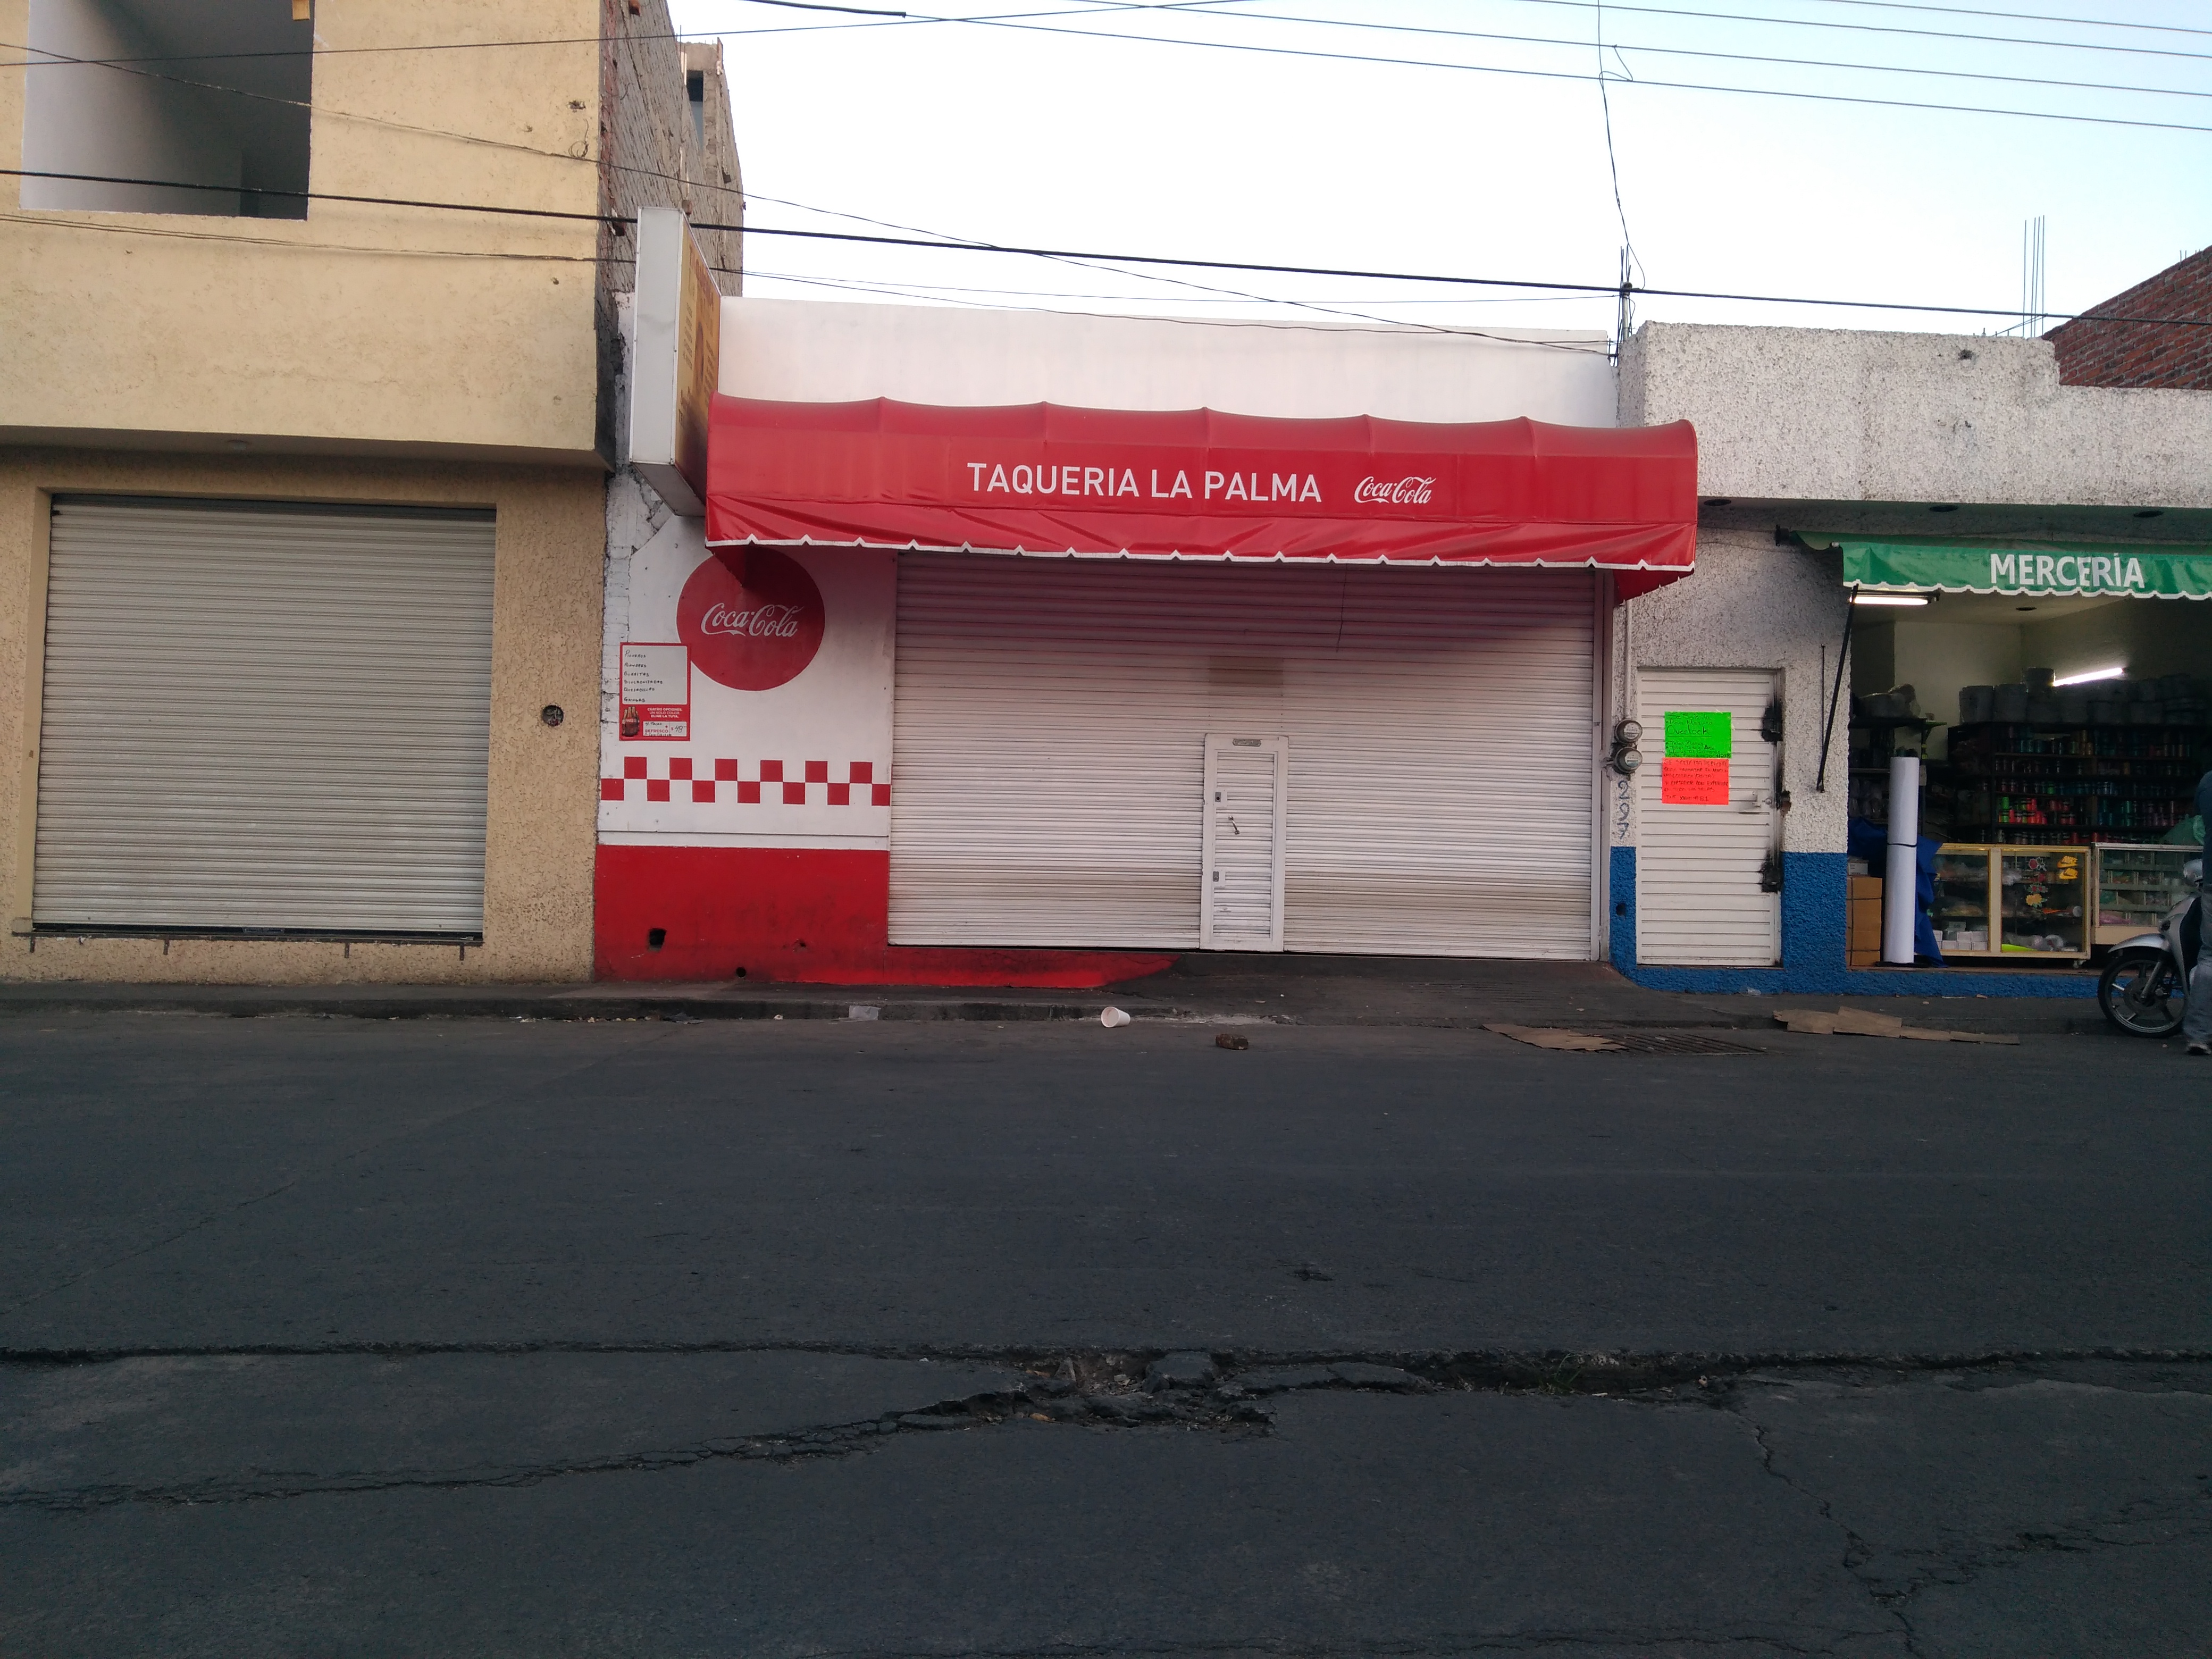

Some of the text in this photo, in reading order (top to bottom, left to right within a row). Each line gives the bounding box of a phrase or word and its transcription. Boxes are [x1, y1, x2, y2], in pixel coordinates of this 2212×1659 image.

[967, 463, 1322, 502] TAQUERIA LA PALMA
[1354, 476, 1436, 504] Coca-Cola
[701, 602, 805, 637] Coca-Cola
